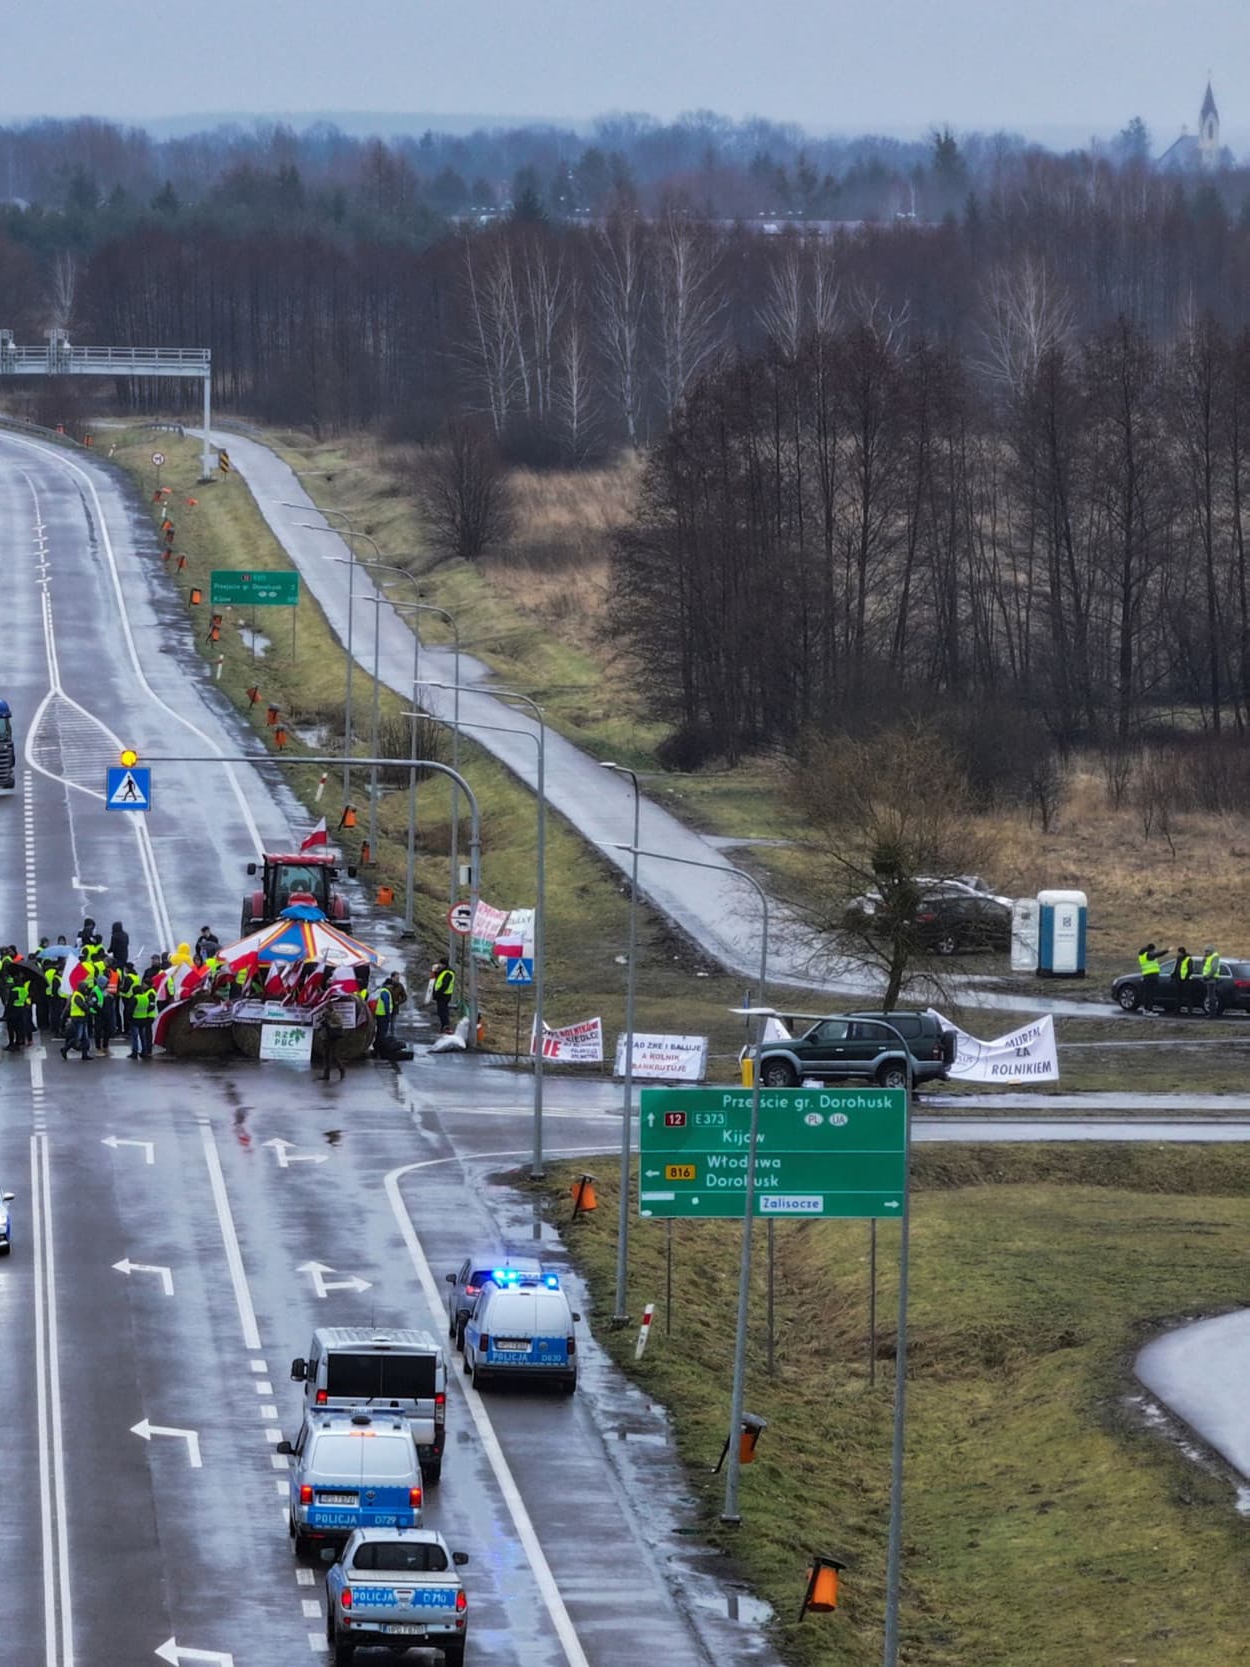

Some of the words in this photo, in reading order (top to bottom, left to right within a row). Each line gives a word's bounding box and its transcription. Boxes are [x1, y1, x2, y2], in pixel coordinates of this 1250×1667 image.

[671, 1043, 701, 1051] BALUJE
[1015, 1048, 1031, 1057] ZA
[991, 1061, 1052, 1075] ROLNIKIEM
[723, 1094, 789, 1108] Przeście
[794, 1098, 813, 1111] gr.
[820, 1095, 892, 1108] Dorohusk
[669, 1115, 682, 1125] 12
[695, 1114, 725, 1125] E373
[808, 1115, 819, 1124] PL
[832, 1115, 845, 1124] UA
[707, 1155, 781, 1168] Włodwa
[670, 1168, 690, 1178] 816
[763, 1198, 819, 1209] Zalisocze
[493, 1352, 528, 1361] POLICJA
[315, 1513, 357, 1524] POLICJA
[354, 1593, 394, 1601] POLICJA
